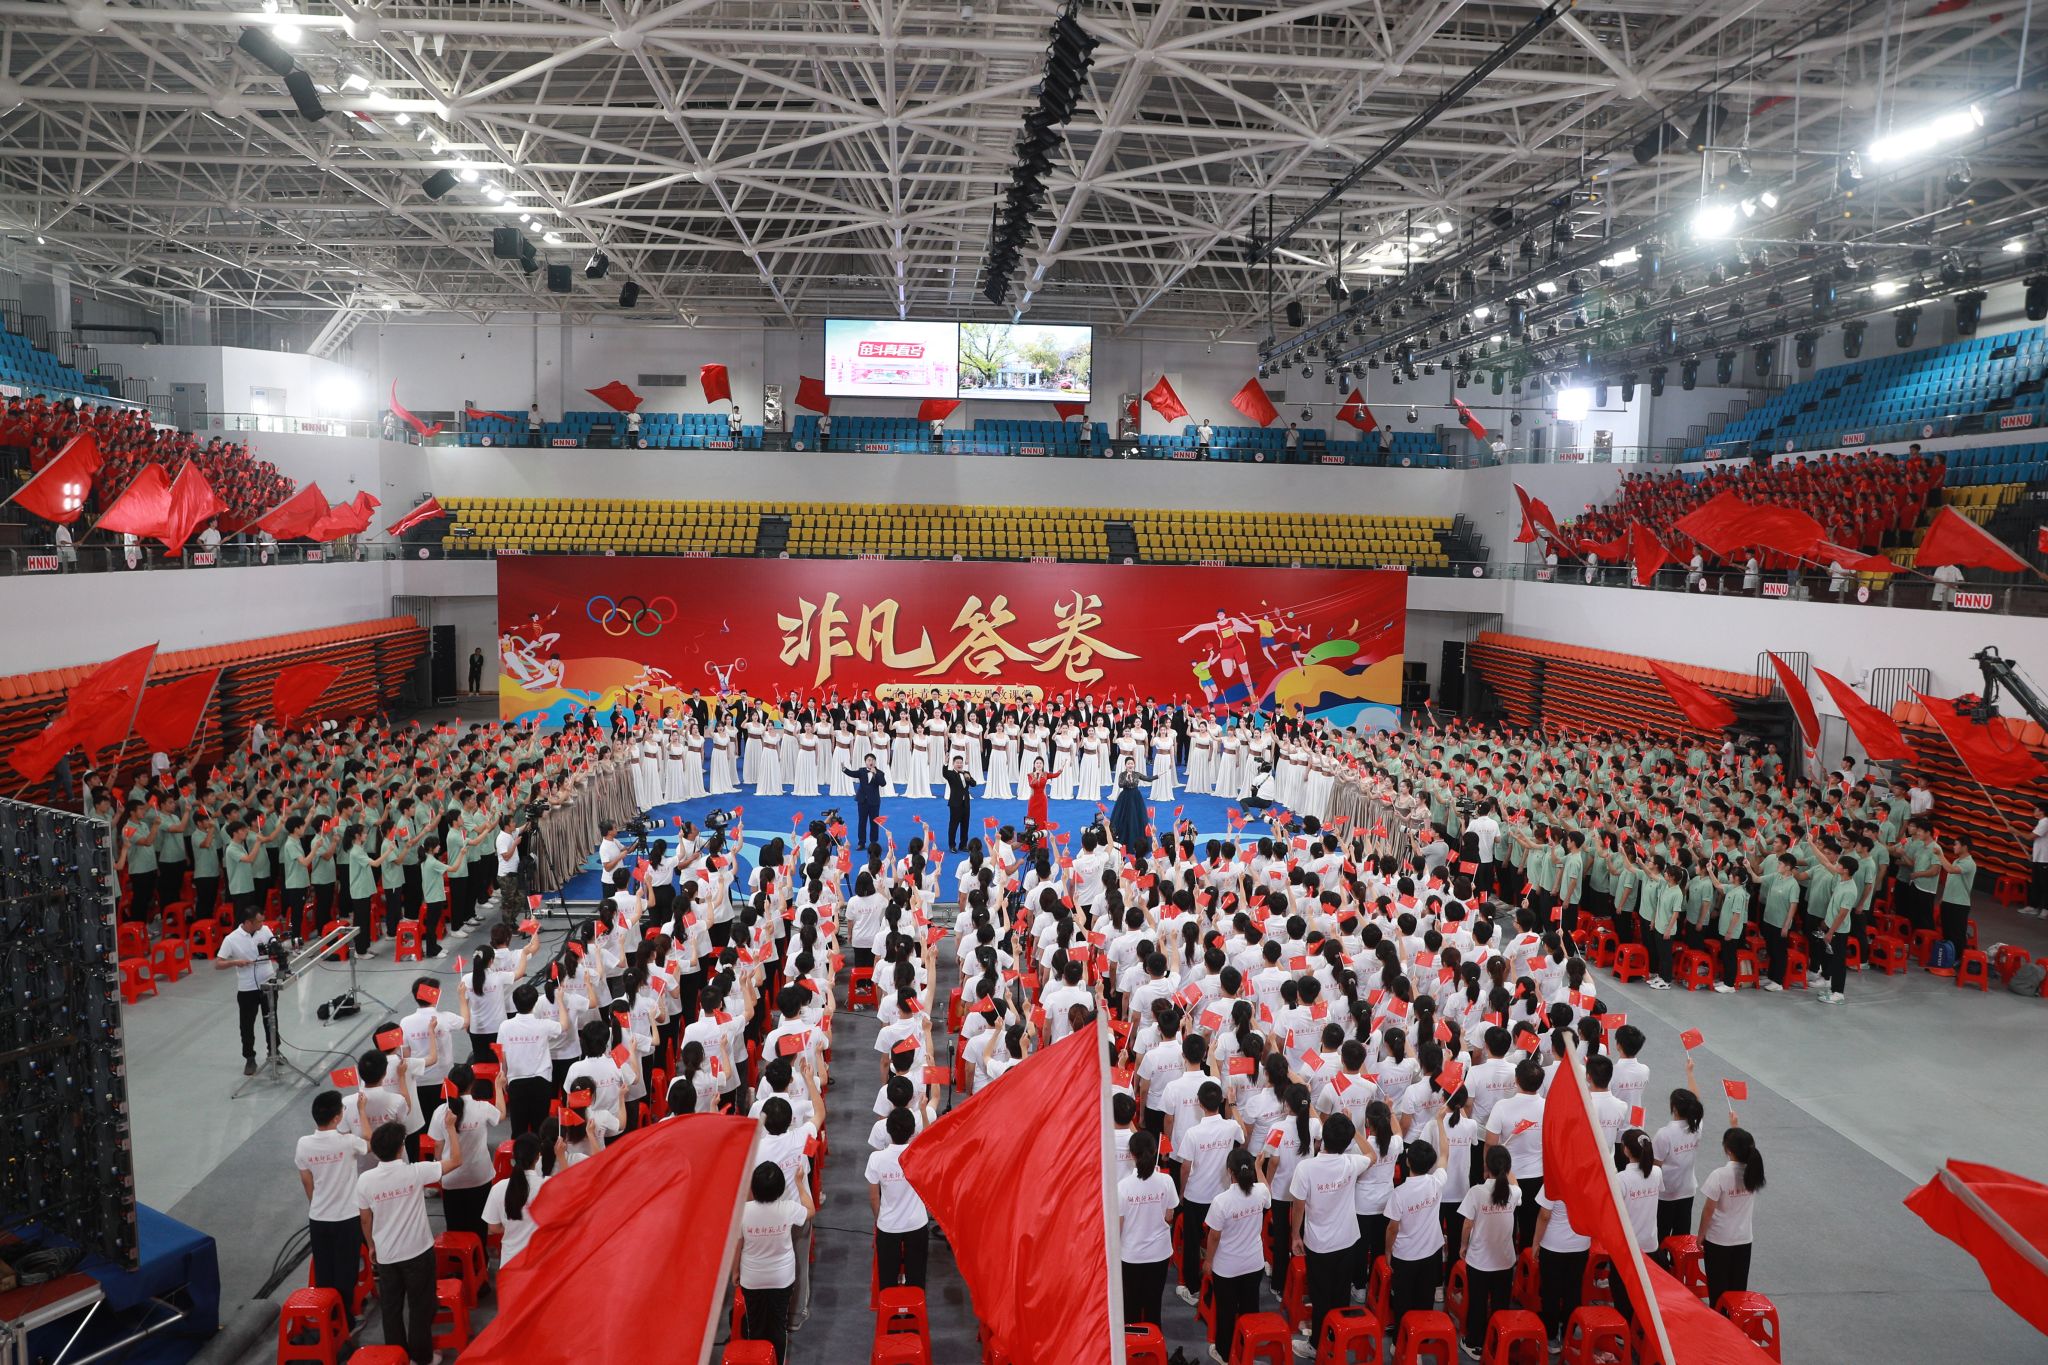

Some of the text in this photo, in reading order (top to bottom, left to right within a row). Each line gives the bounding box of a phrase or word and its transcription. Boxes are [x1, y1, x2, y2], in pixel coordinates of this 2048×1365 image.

[2001, 413, 2032, 428] HNNU
[302, 423, 328, 432] HNNU
[553, 439, 577, 447] HNNU
[1843, 433, 1865, 445] HNNU
[709, 441, 733, 449] HNNU
[1020, 447, 1044, 455] HNNU
[1173, 451, 1196, 459] HNNU
[1322, 456, 1344, 464] HNNU
[1560, 453, 1584, 461] HNNU
[28, 555, 58, 570] HNNU
[194, 553, 214, 564] HNNU
[1764, 583, 1788, 597] HNNU
[1954, 592, 1992, 609] HNNU
[777, 589, 1142, 688] 非凡答卷
